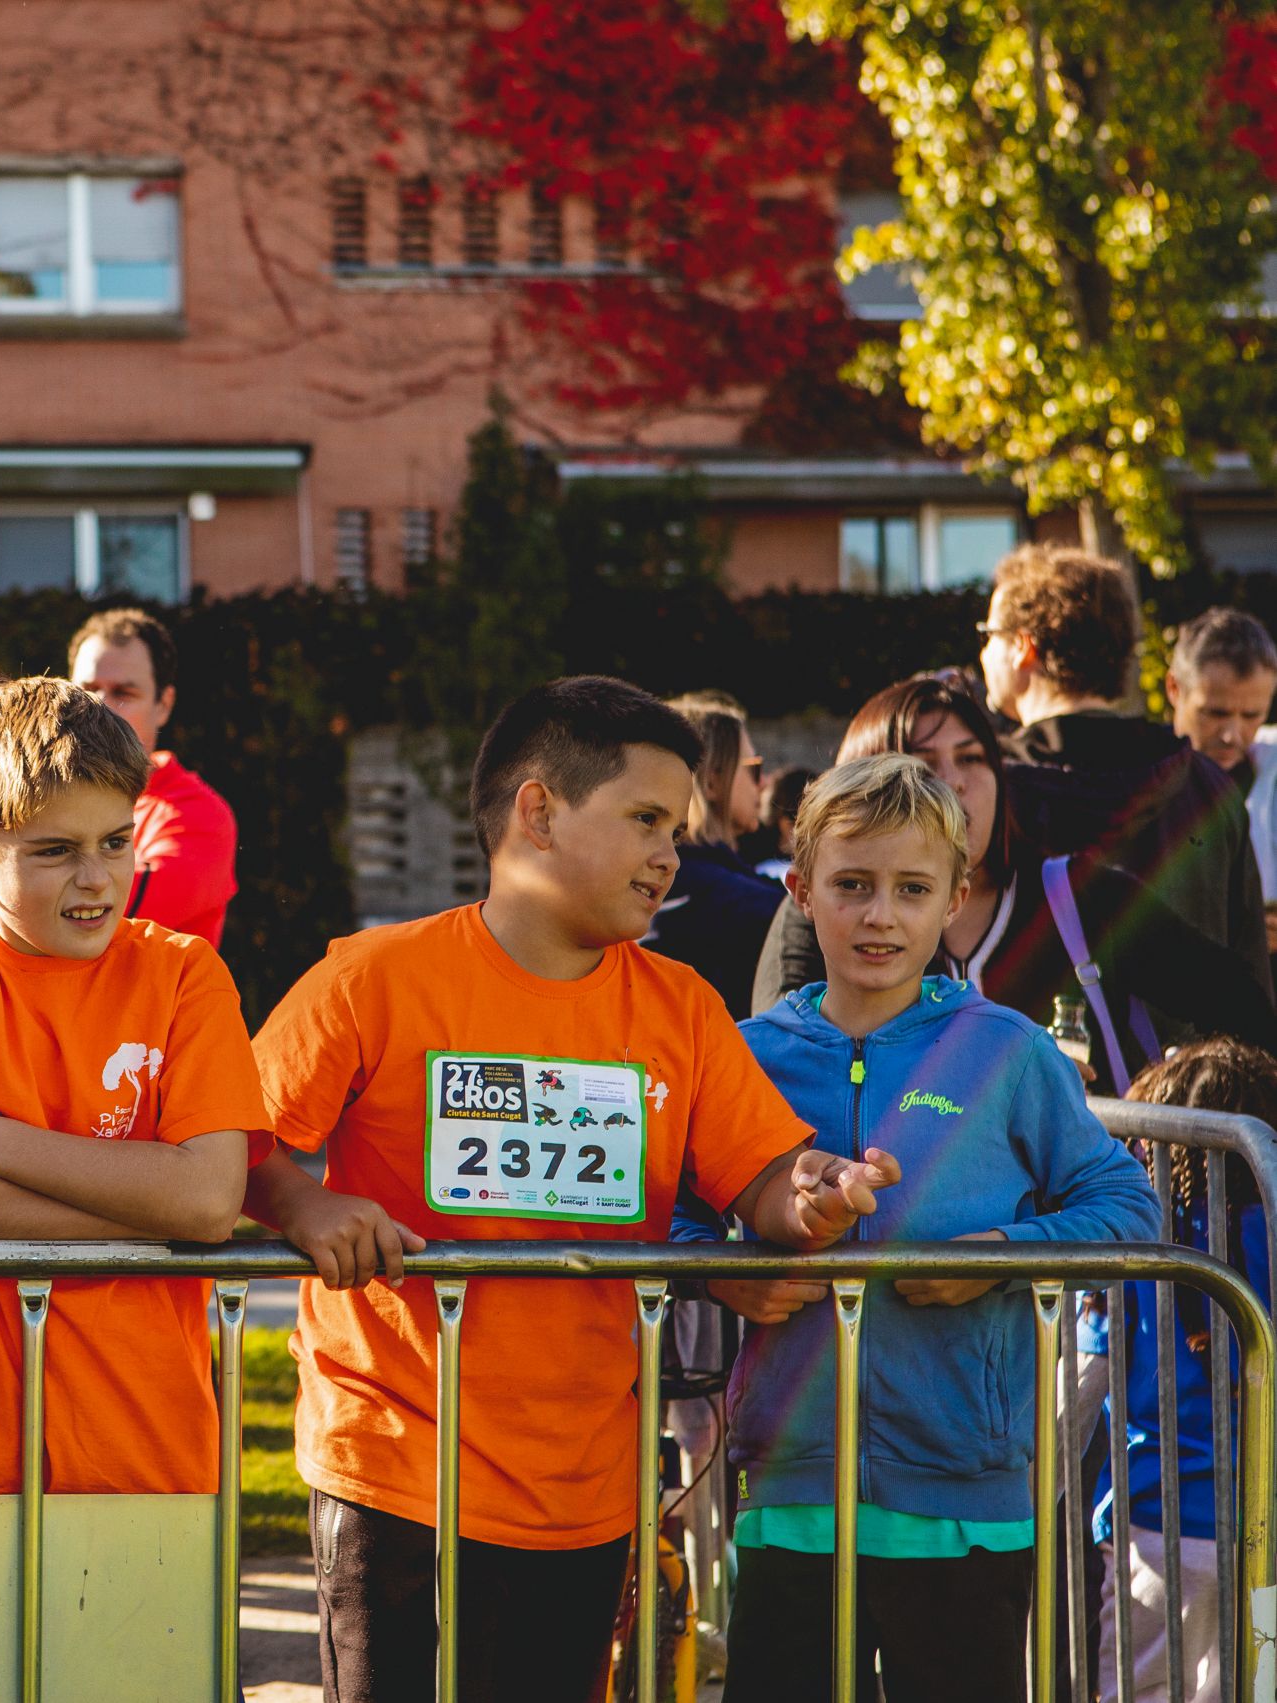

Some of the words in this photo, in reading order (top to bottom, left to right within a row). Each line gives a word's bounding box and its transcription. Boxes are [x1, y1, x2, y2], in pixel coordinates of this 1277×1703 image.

[446, 1085, 522, 1110] CROS
[899, 1088, 947, 1112] Indigo
[500, 1112, 522, 1120] Cugat
[457, 1137, 606, 1184] 2372
